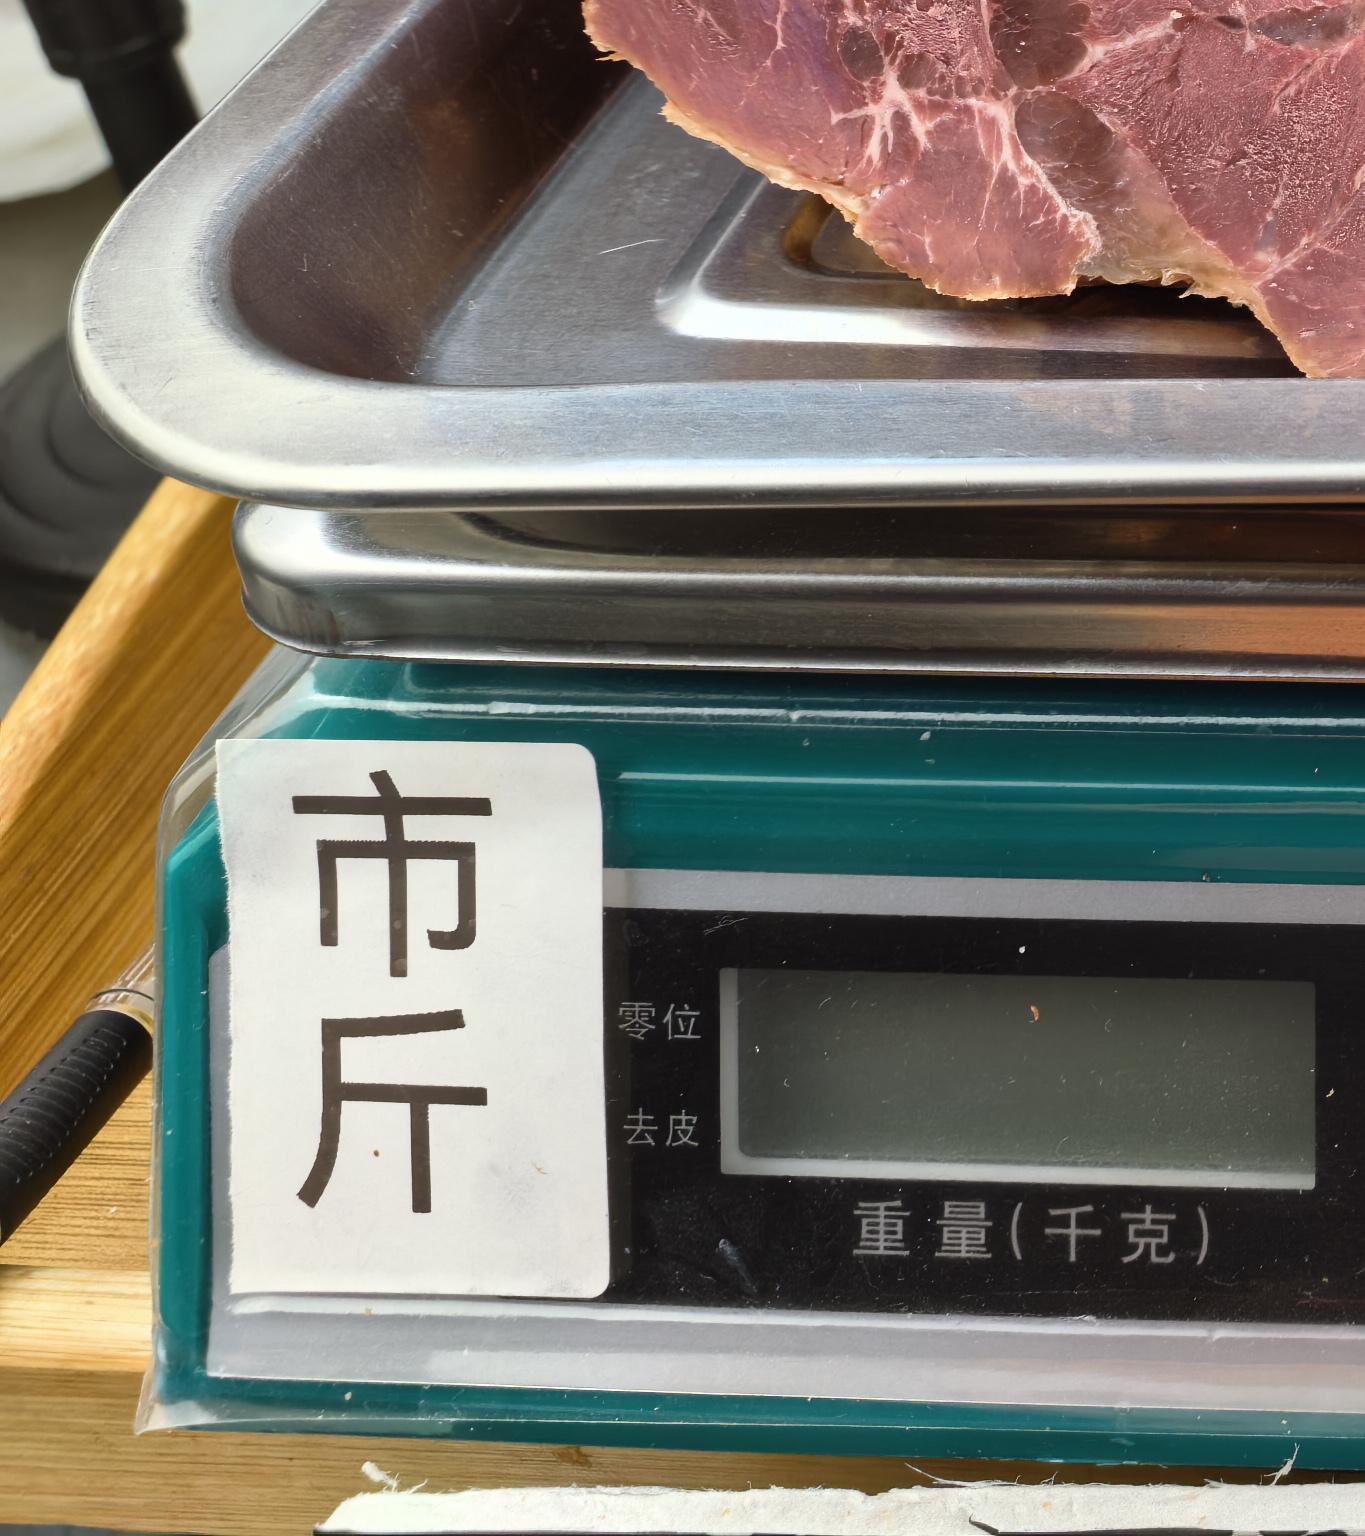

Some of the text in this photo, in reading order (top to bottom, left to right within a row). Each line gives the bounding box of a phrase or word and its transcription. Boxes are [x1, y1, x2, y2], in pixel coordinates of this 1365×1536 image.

[291, 769, 493, 1214] 市斤
[618, 1001, 702, 1040] 零位
[623, 1107, 700, 1147] 去皮
